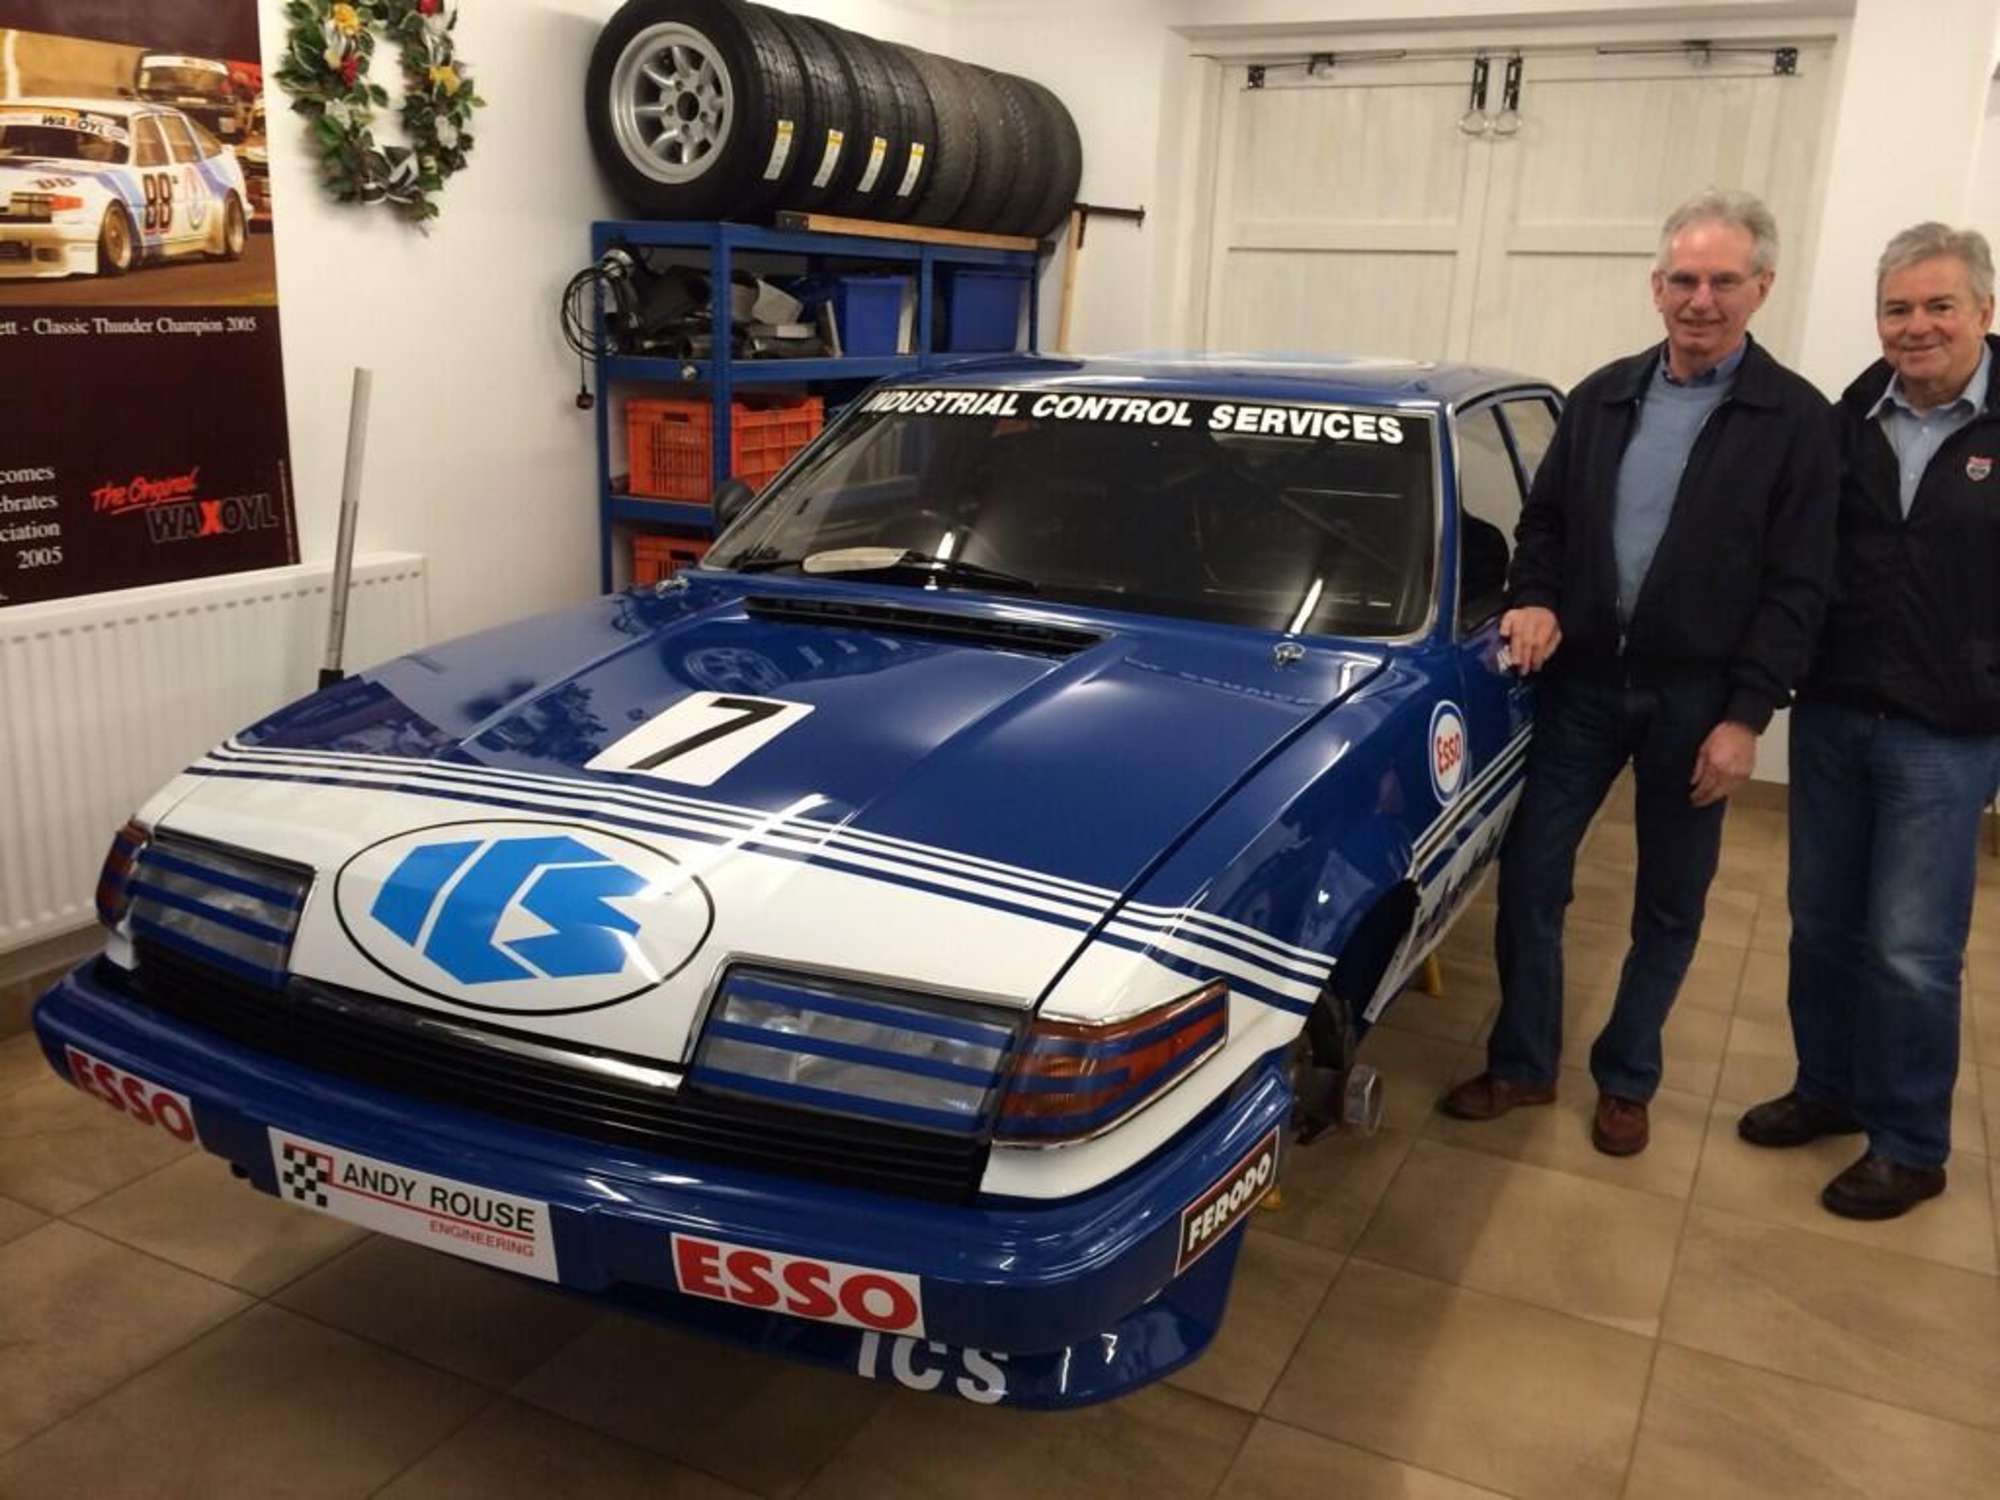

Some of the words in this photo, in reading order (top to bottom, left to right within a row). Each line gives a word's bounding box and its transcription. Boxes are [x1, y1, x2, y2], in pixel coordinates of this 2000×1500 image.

[143, 172, 173, 234] 88
[33, 317, 89, 335] Classic
[93, 317, 153, 334] Thunder
[156, 316, 223, 336] Champion
[226, 316, 256, 332] 2005
[860, 390, 1019, 416] INDUSTRIAL
[1031, 394, 1193, 427] CONTROL
[1208, 404, 1404, 445] SERVICES
[91, 482, 126, 512] The
[128, 466, 199, 507] Original
[146, 493, 279, 544] WAXOYL
[17, 546, 63, 569] 2005
[627, 697, 788, 770] 7
[69, 1051, 194, 1142] ESSO
[343, 1163, 417, 1201] ANDY
[429, 1186, 535, 1234] ROUSE
[1187, 1153, 1272, 1252] FERODO
[429, 1219, 535, 1257] ENGINEERING
[676, 1238, 918, 1330] ESSO
[858, 1331, 1009, 1404] ICS
